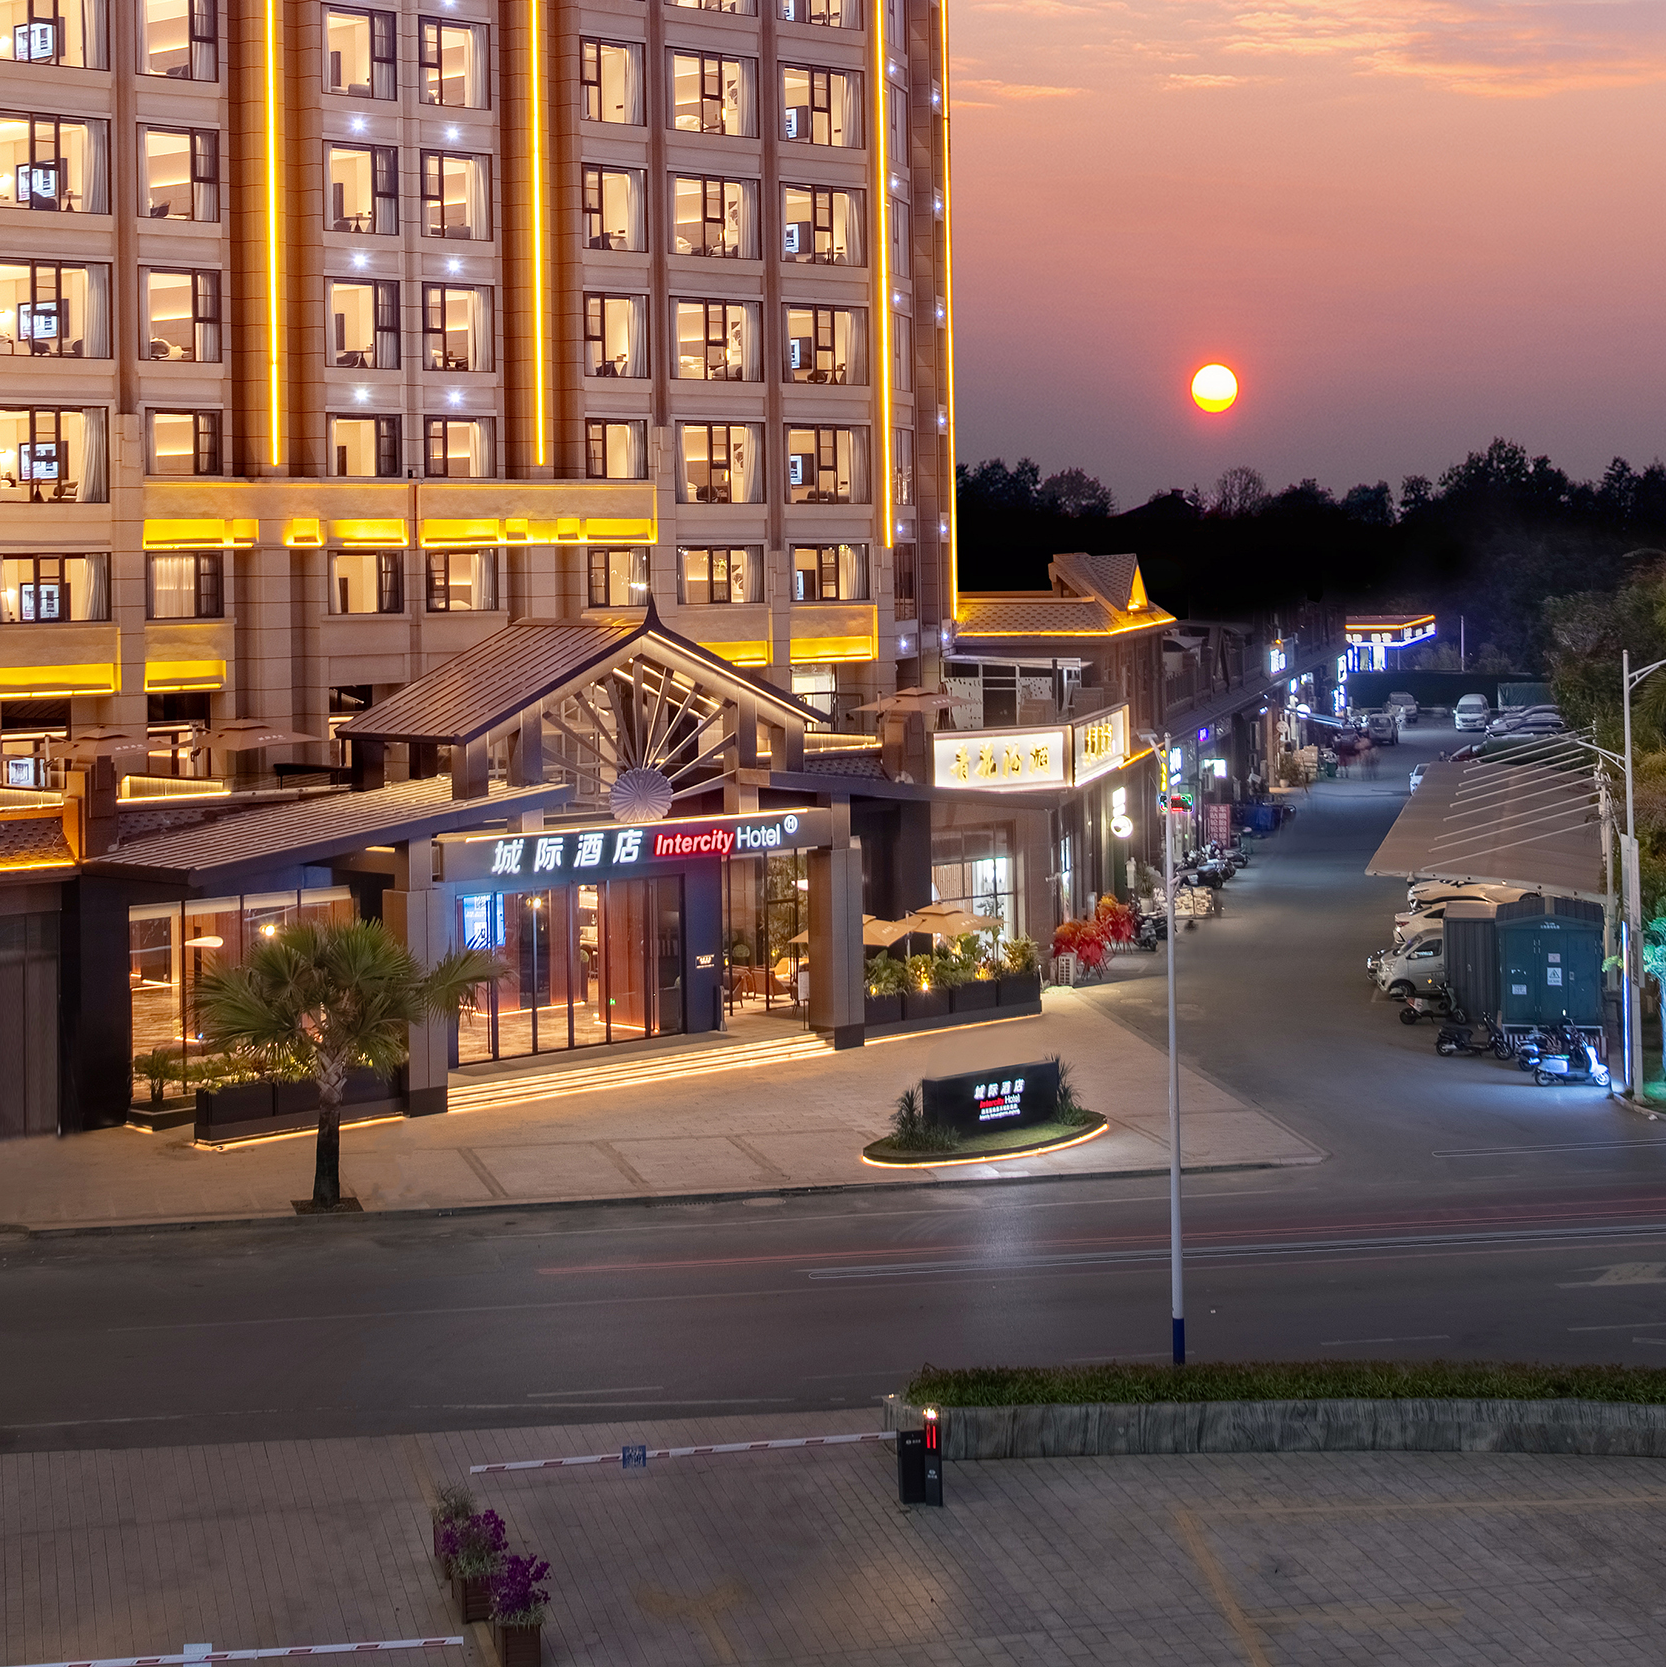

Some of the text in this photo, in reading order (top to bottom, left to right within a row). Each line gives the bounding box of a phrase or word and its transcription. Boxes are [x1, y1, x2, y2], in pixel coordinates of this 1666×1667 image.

[491, 829, 643, 875] 城际酒店
[655, 828, 734, 856] Intercity
[736, 823, 781, 850] Hotel
[974, 1078, 1025, 1100] 城际酒店
